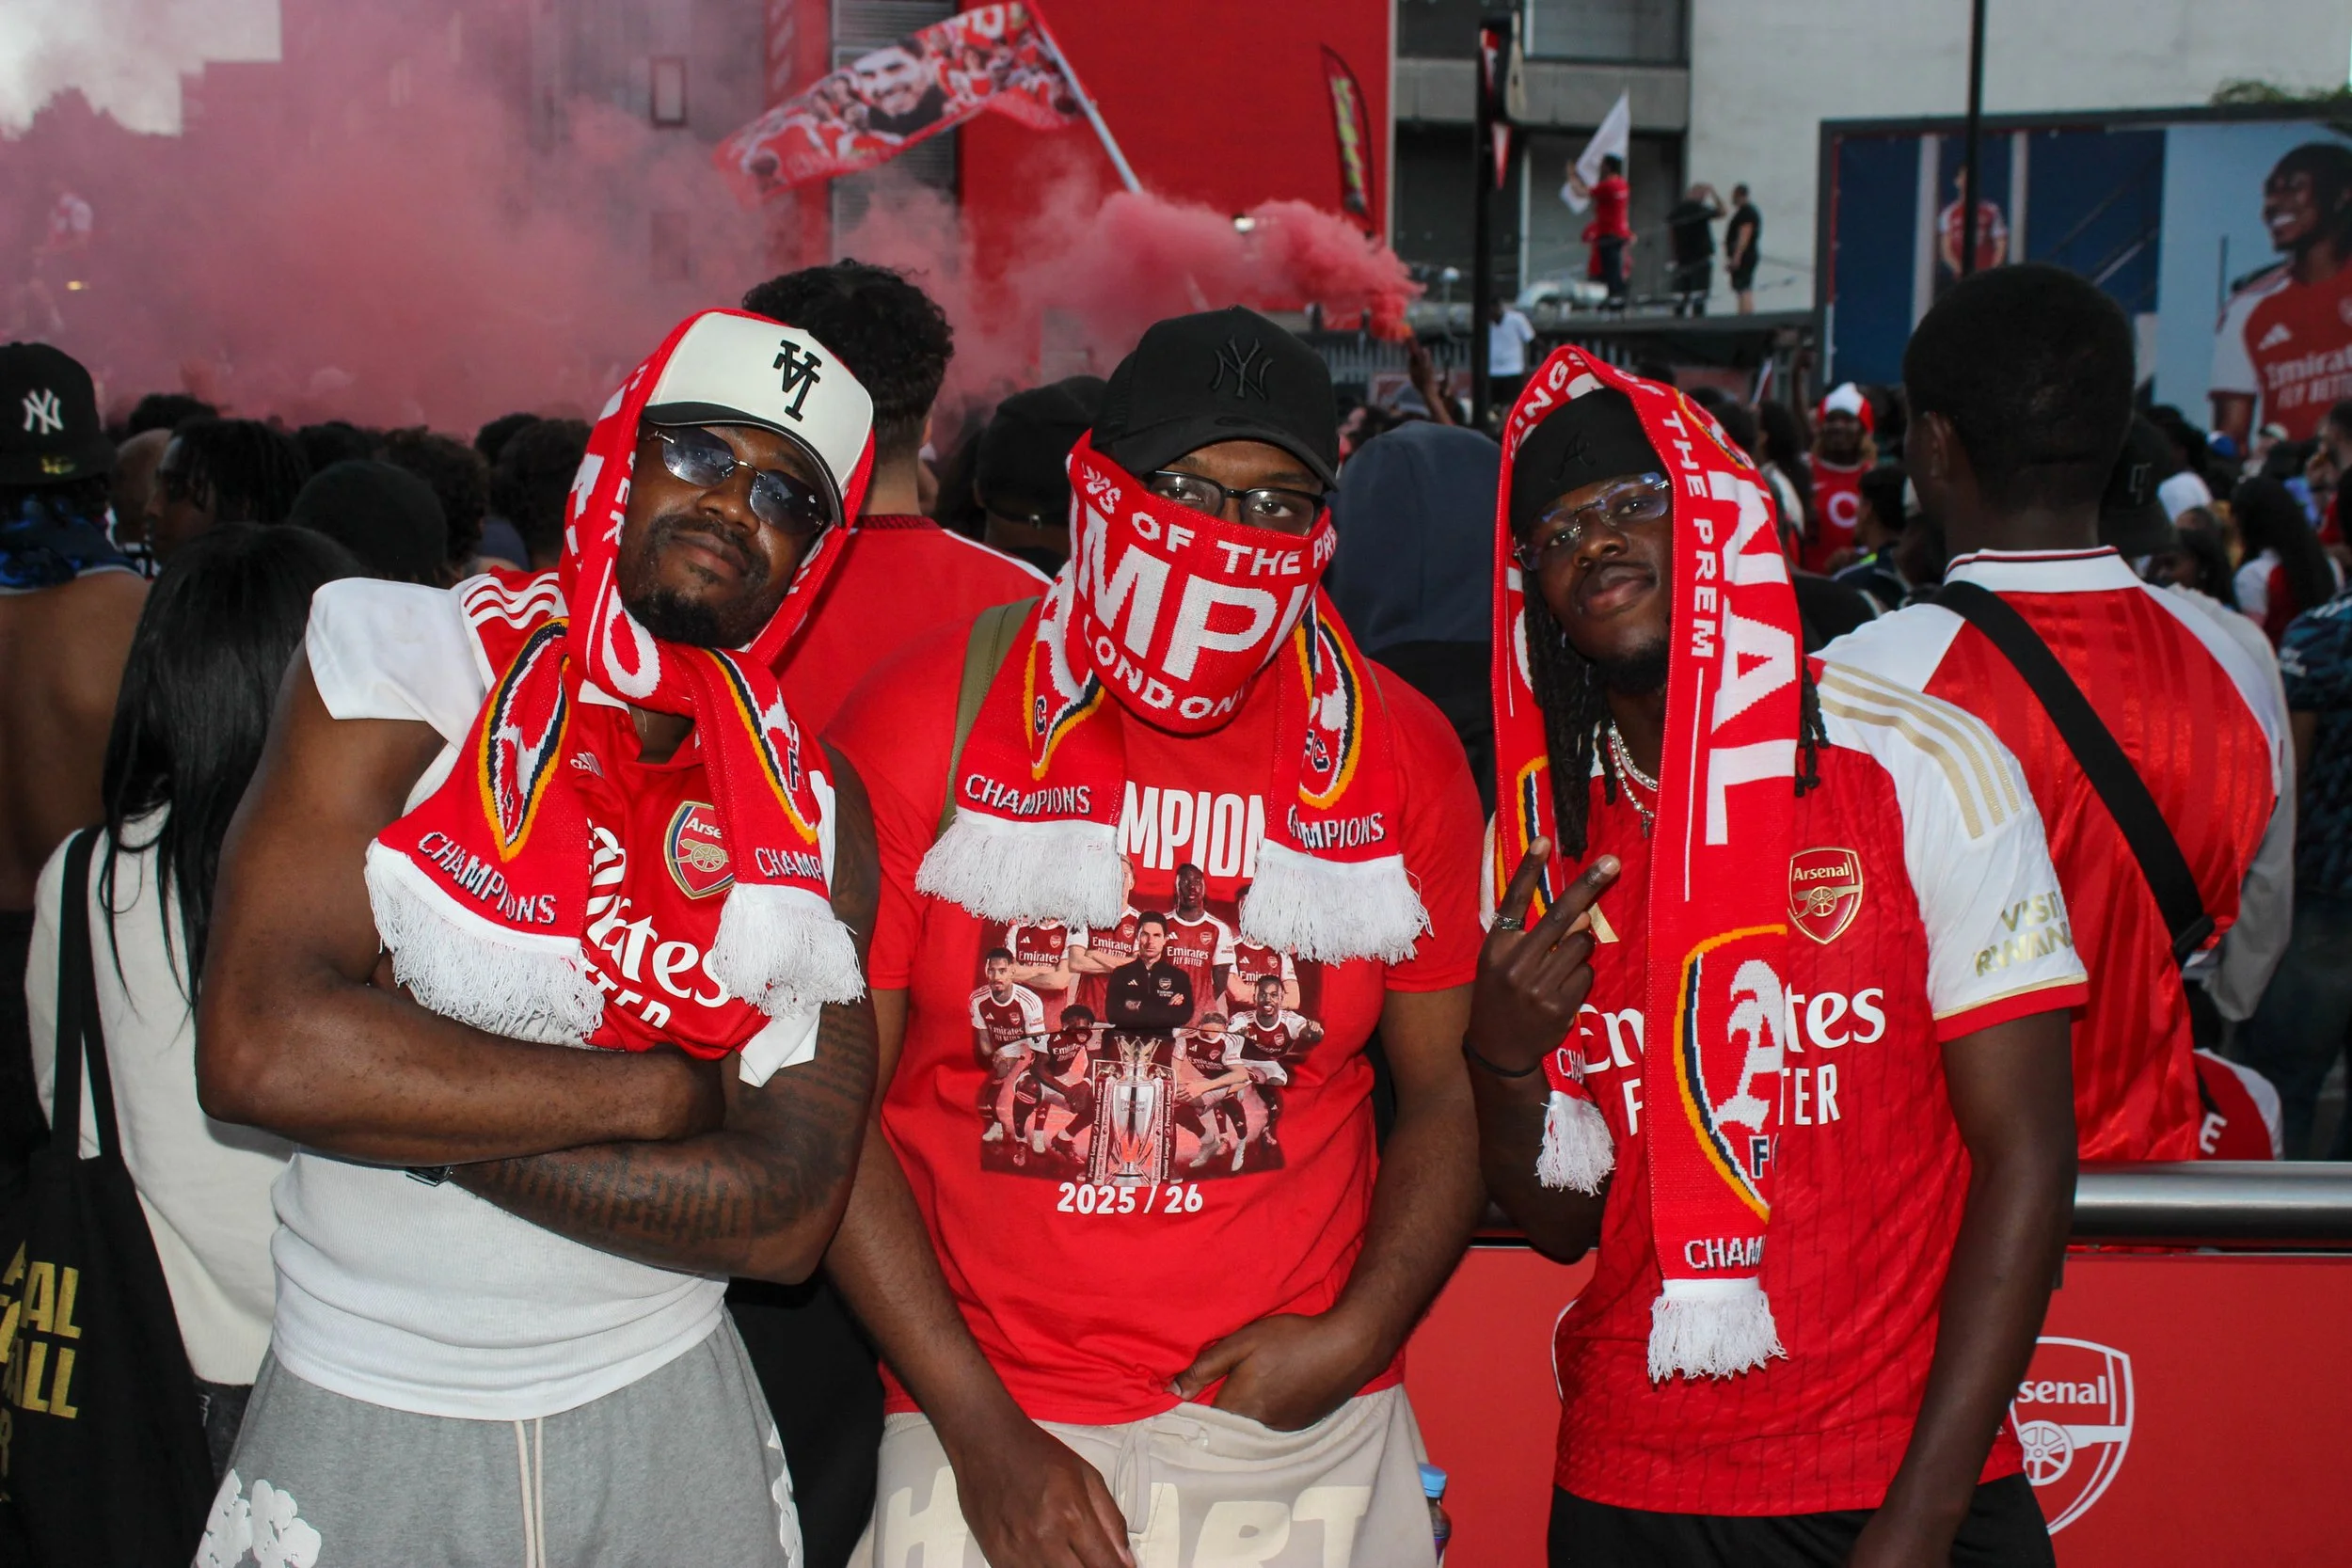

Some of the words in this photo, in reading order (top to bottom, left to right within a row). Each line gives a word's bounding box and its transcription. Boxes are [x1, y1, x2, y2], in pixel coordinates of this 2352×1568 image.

[1211, 336, 1272, 401] NY
[23, 388, 64, 435] NY
[1132, 511, 1195, 552] OF
[1217, 541, 1301, 576] THE
[1662, 411, 1708, 498] THE
[1692, 518, 1717, 658] PREM
[964, 773, 1091, 816] CHAMPIONS
[685, 816, 723, 839] Arse
[1118, 781, 1265, 879] MPION
[1288, 803, 1385, 849] CMPIONS
[418, 832, 557, 925] CHAMPIONS
[755, 847, 823, 881] CHAMP
[1793, 863, 1851, 882] Arsenal
[1018, 951, 1060, 963] Emirates
[1092, 936, 1133, 953] Emirates
[1167, 946, 1210, 958] Emirates
[1975, 921, 2073, 977] RWAN
[1057, 1182, 1136, 1214] 2025
[1164, 1183, 1204, 1213] 26
[2016, 1375, 2107, 1404] senal
